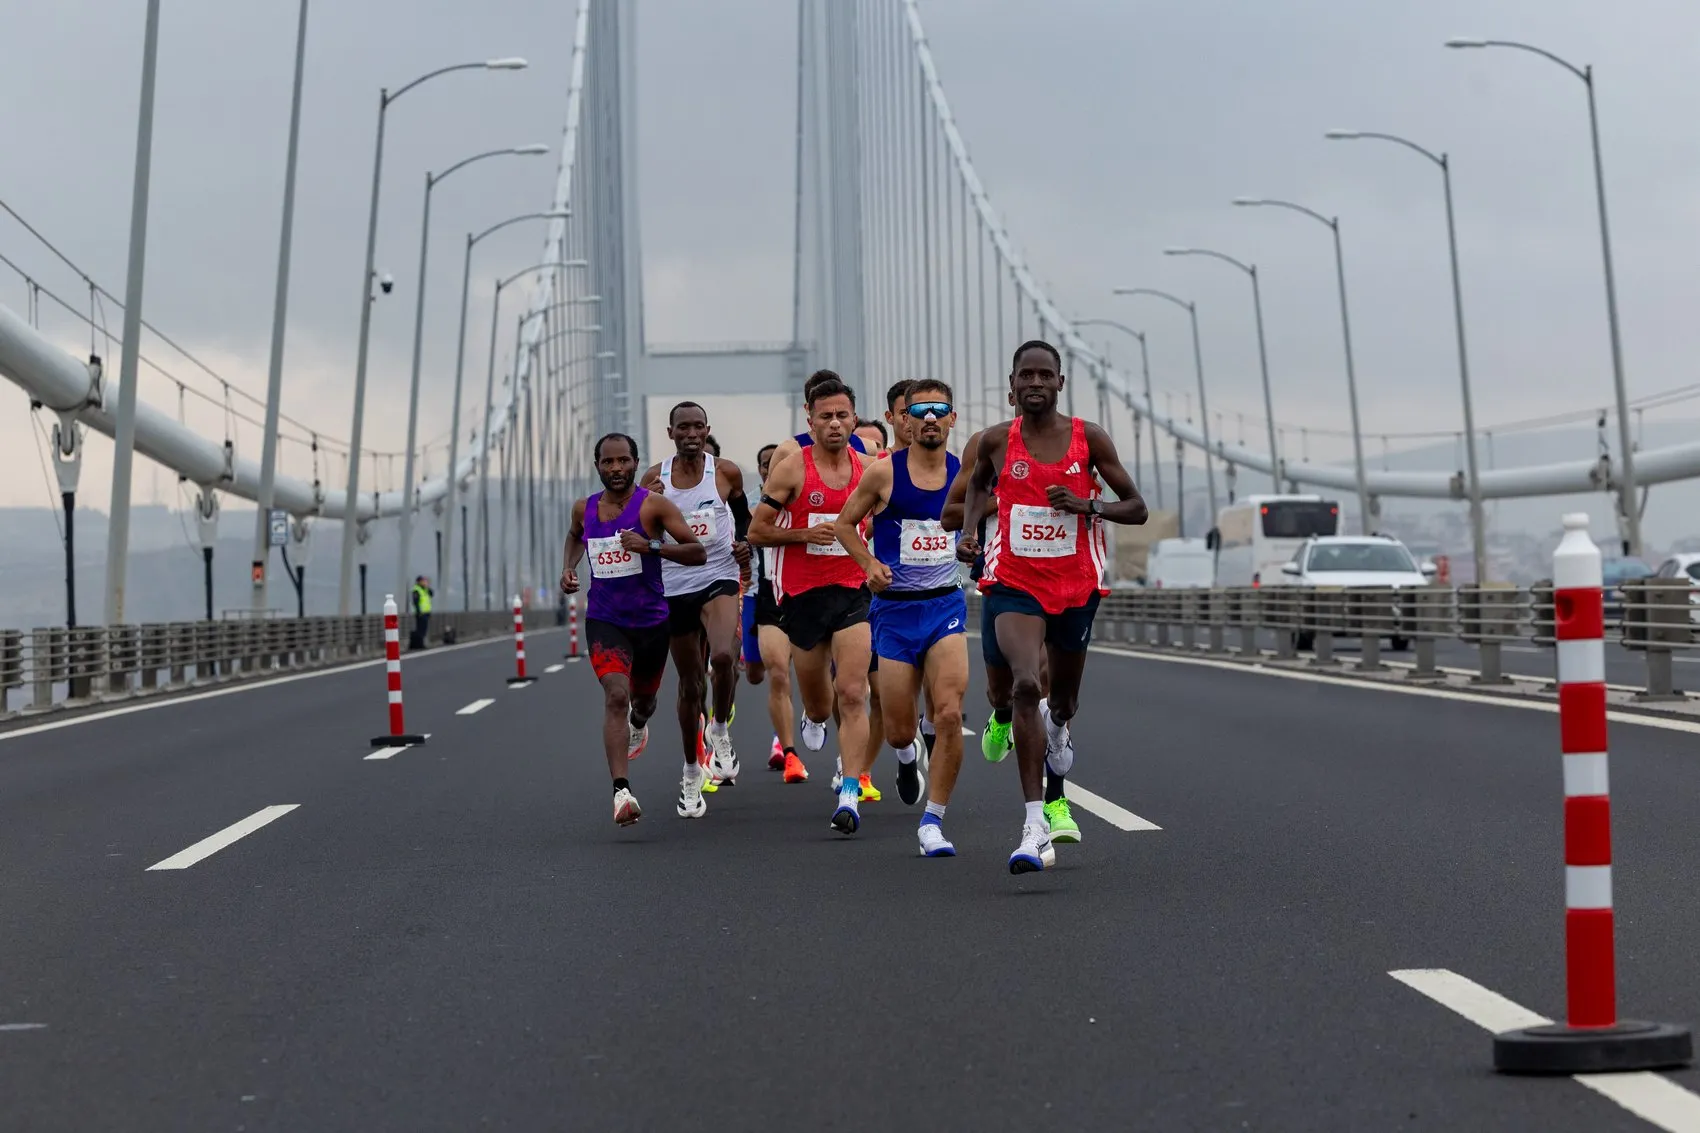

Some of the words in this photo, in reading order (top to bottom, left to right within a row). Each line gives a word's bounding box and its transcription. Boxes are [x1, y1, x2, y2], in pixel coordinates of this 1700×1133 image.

[691, 524, 708, 536] 22
[1022, 524, 1067, 540] 5524
[912, 536, 947, 551] 6333
[598, 550, 631, 565] 6336
